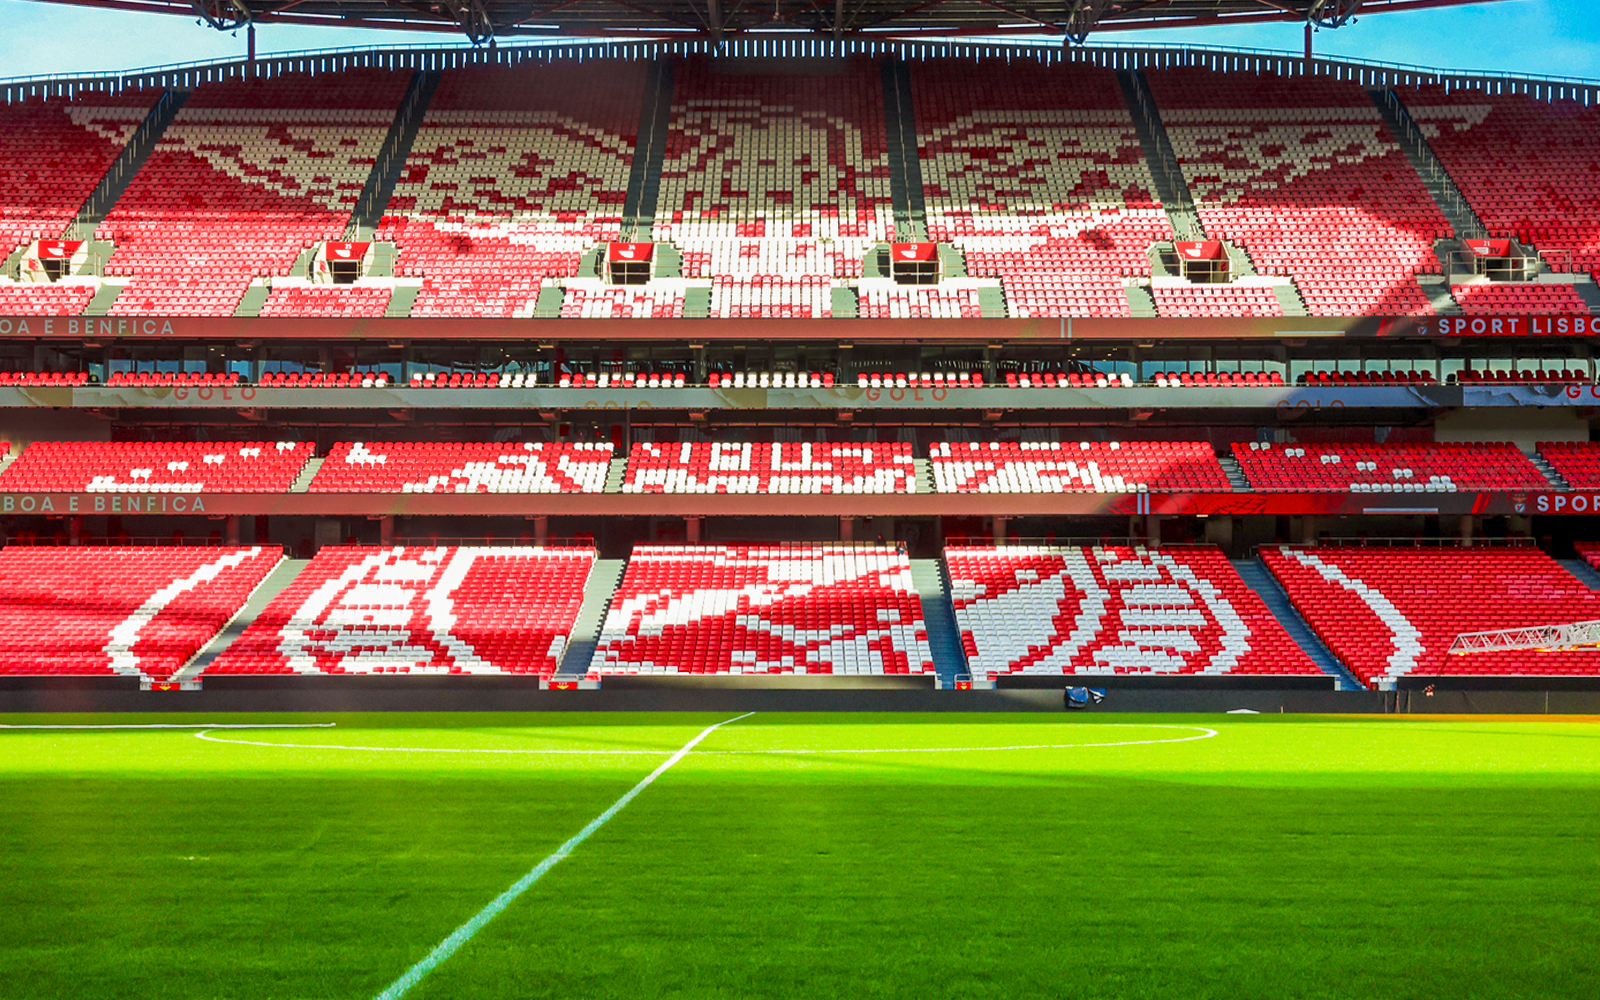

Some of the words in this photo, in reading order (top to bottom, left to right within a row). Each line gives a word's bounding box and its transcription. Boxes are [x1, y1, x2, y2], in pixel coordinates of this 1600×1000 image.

[44, 319, 54, 334] E
[68, 319, 174, 335] BENFICA
[1438, 318, 1519, 334] SPORT
[173, 386, 256, 400] GOLO
[866, 387, 948, 401] GOLO
[3, 496, 54, 511] BOA
[69, 496, 79, 511] E
[94, 496, 205, 511] BENFICA
